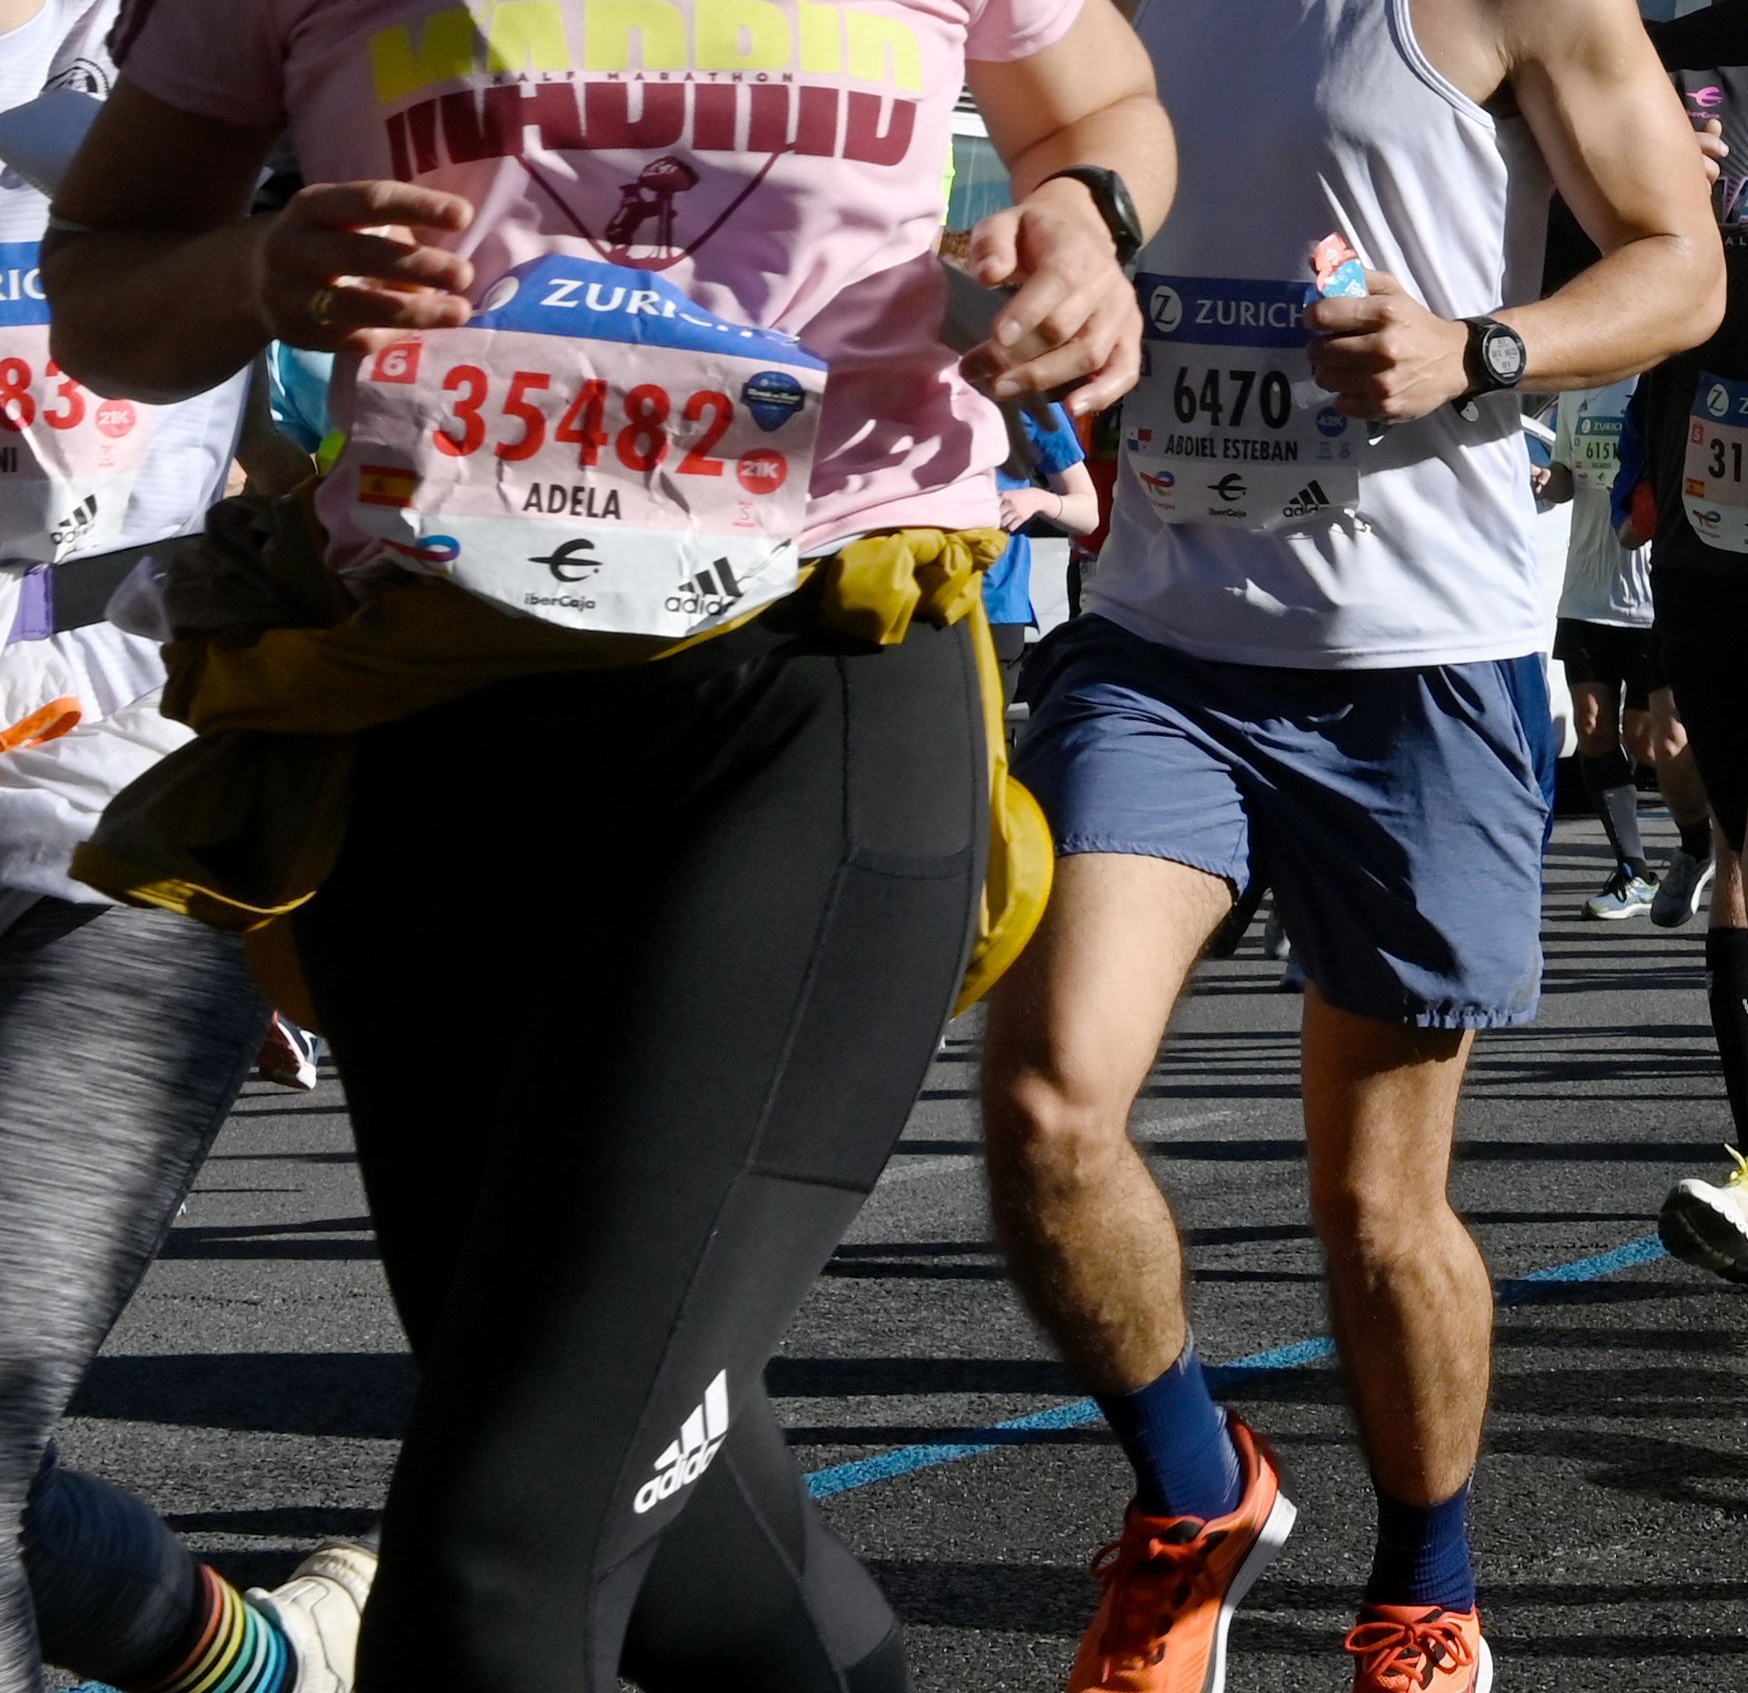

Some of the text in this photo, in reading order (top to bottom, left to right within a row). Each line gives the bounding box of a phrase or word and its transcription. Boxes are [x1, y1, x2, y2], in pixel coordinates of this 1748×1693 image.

[493, 71, 796, 86] HALF MARATHON
[541, 278, 752, 339] ZURI
[382, 349, 408, 377] 6
[1173, 366, 1292, 429] 6470
[99, 410, 130, 425] 21K
[432, 363, 735, 477] 35482
[1164, 433, 1218, 459] ABDIEL
[1223, 437, 1299, 462] ESTEBAN
[741, 461, 777, 480] 21K
[523, 482, 622, 521] ADELA
